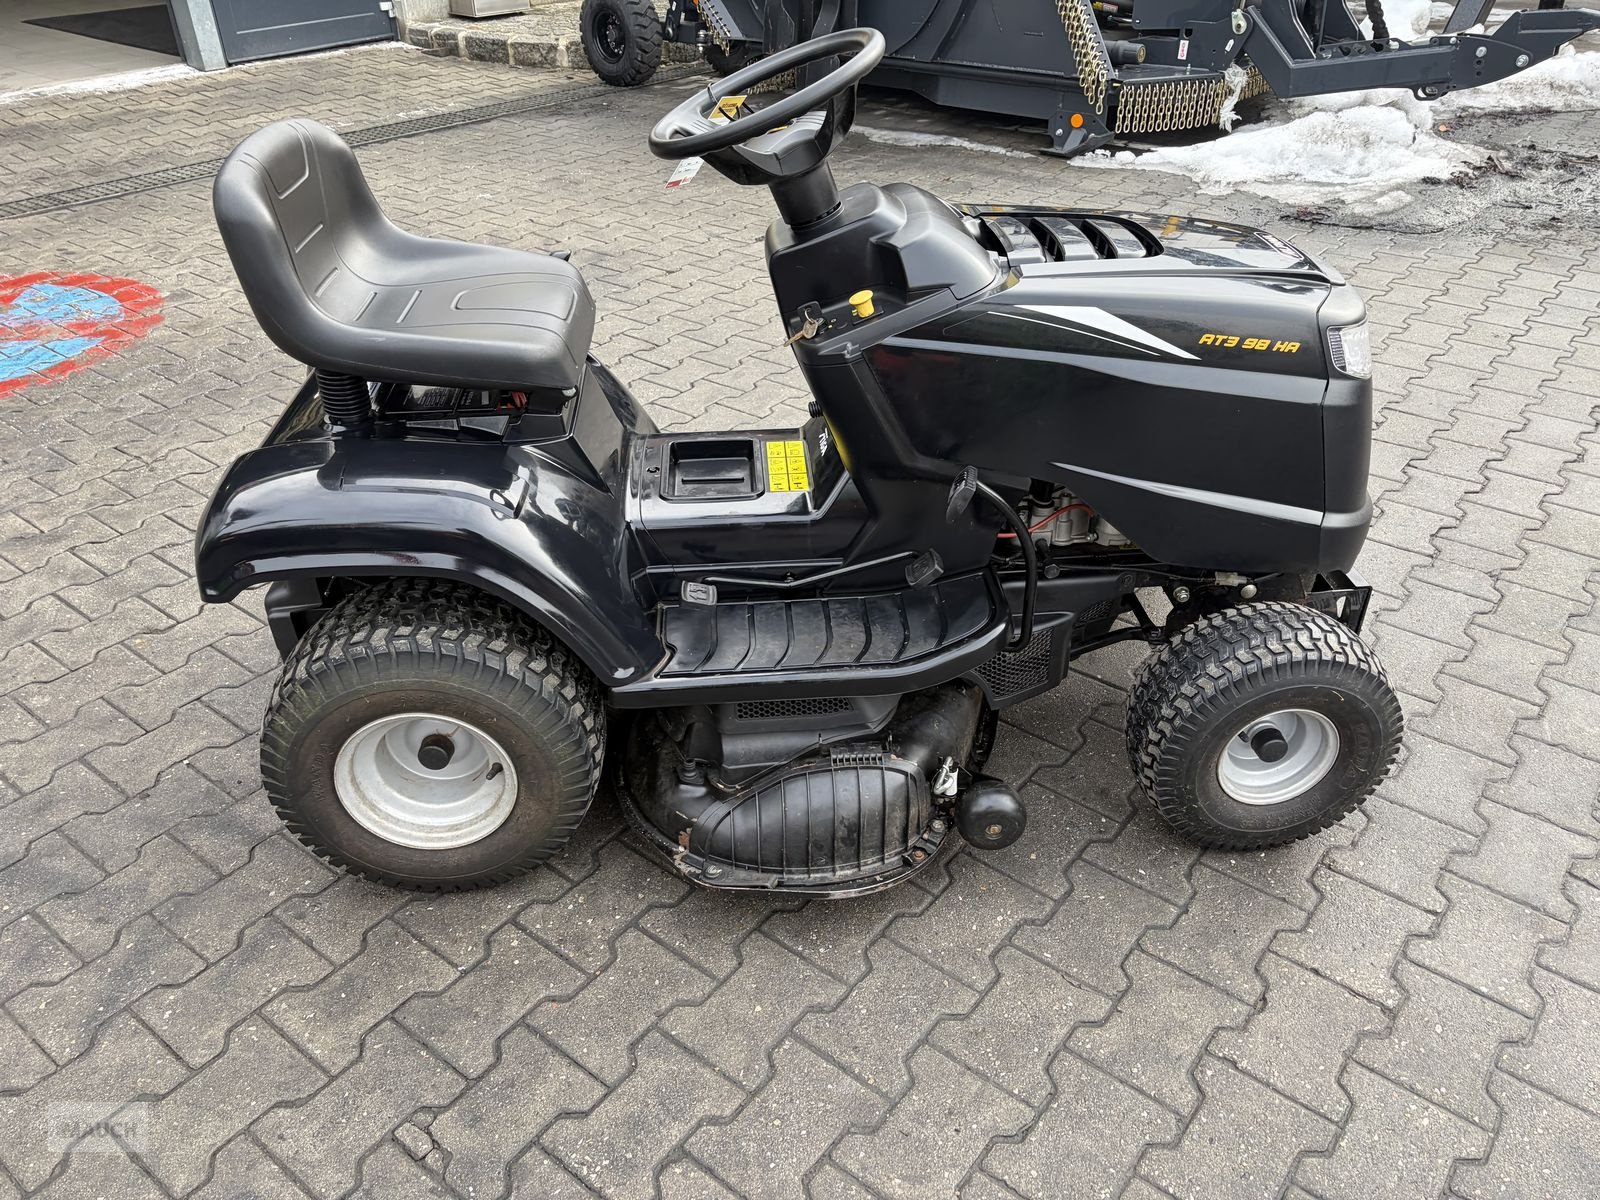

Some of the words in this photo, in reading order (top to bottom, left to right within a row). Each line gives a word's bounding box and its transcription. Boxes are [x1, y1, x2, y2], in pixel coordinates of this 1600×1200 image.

[1199, 333, 1240, 347] AT3
[1242, 337, 1272, 351] 98
[1272, 340, 1301, 353] HA
